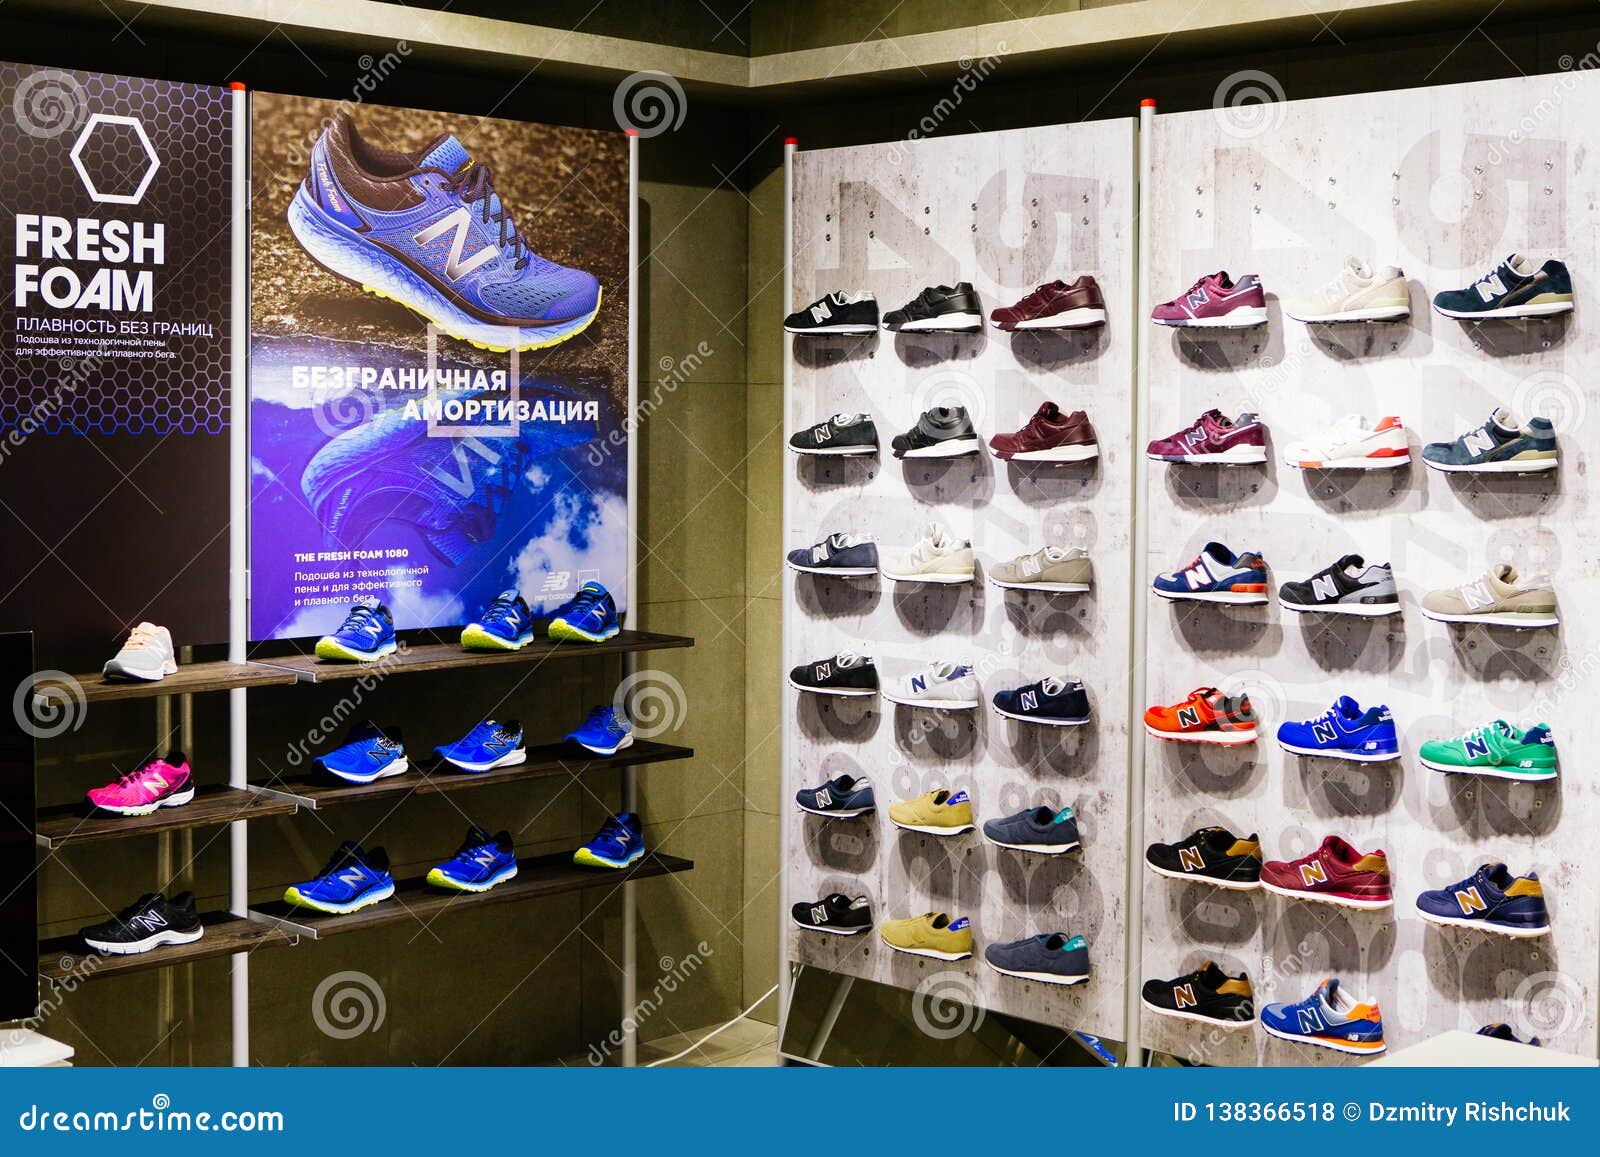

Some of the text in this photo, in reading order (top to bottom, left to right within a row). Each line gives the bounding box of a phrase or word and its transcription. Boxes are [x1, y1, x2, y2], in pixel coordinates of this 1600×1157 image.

[16, 213, 165, 265] FRESH
[15, 264, 153, 312] FOAM
[1187, 288, 1209, 310] N
[1476, 273, 1508, 303] N
[810, 302, 832, 324] N
[16, 317, 213, 338] ПЛАВНОСТЬ БЕЗ ГРАНИЦ
[16, 335, 166, 347] Подошва из технологичной пены
[15, 348, 33, 357] для
[35, 347, 102, 358] эффективного
[111, 349, 153, 359] плавного
[155, 350, 177, 359] бега.
[292, 365, 506, 391] БЕЗГРАНИЧНАЯ
[402, 398, 599, 424] АМОРТИЗАЦИЯ
[815, 423, 832, 443] N
[1184, 426, 1207, 447] N
[1463, 428, 1495, 457] N
[294, 549, 409, 562] THE FRESH FOAM 1080
[813, 543, 829, 563] N
[294, 571, 340, 581] Подошва
[357, 565, 429, 578] технологичной
[1185, 565, 1212, 590] N
[294, 585, 320, 594] пены
[331, 584, 349, 593] для
[352, 579, 423, 592] эффективного
[1312, 574, 1339, 601] N
[1461, 582, 1495, 610] N
[303, 596, 350, 606] плавного
[815, 662, 831, 680] N
[911, 674, 928, 694] N
[1021, 690, 1039, 711] N
[1178, 707, 1200, 728] N
[1312, 721, 1338, 744] N
[1464, 736, 1491, 760] N
[815, 788, 832, 808] N
[1179, 846, 1205, 872] N
[1299, 860, 1328, 887] N
[1454, 885, 1487, 915] N
[811, 905, 828, 924] N
[1174, 983, 1198, 1009] N
[1297, 1007, 1325, 1033] N
